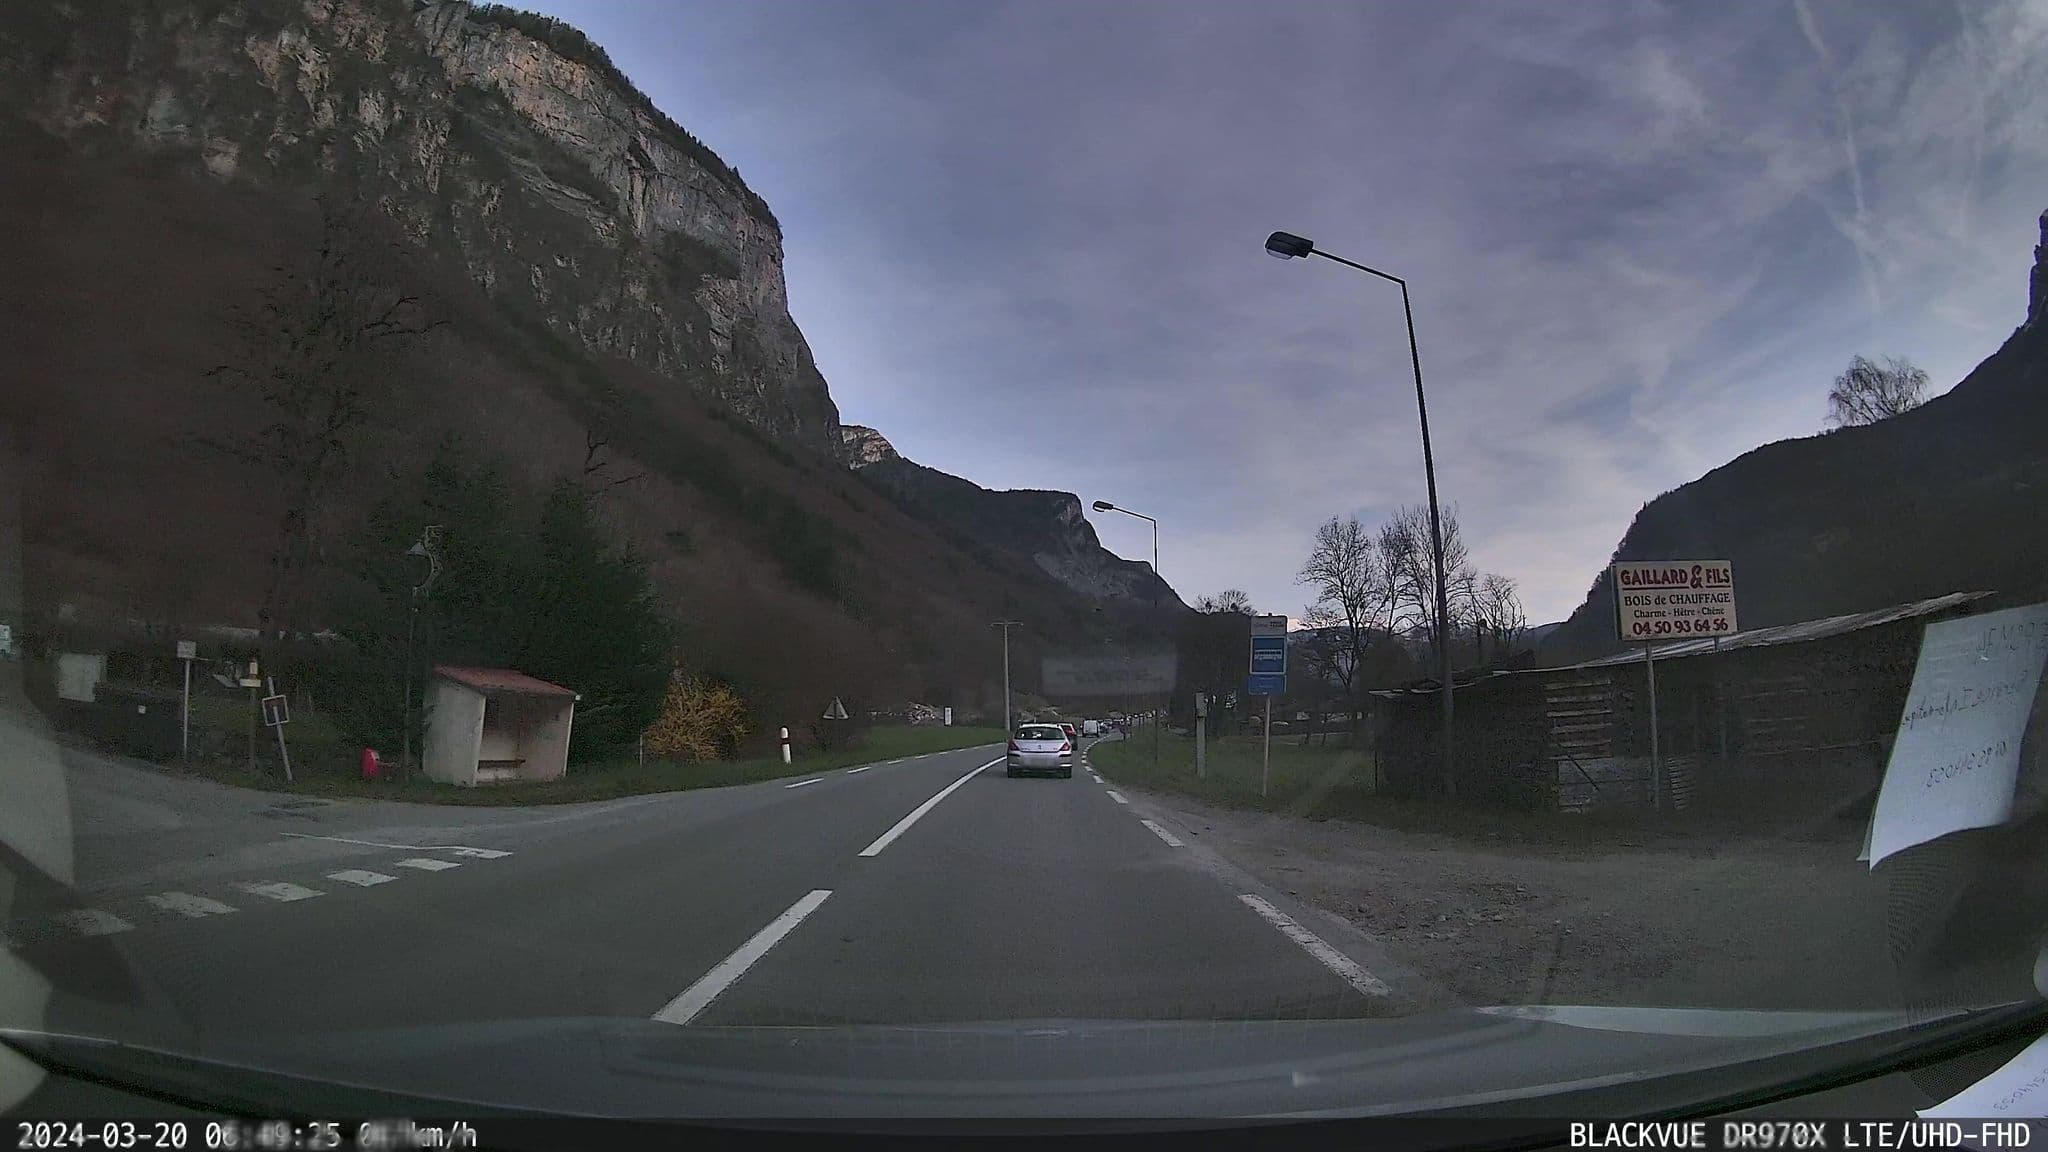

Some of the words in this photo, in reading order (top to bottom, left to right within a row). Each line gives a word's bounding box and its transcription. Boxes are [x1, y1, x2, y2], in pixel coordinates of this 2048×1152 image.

[1620, 568, 1688, 586] GAILLARD
[1690, 565, 1704, 589] &
[1705, 568, 1730, 584] FILS
[1624, 595, 1652, 606] BOIS
[1654, 595, 1667, 605] de
[1669, 593, 1731, 604] CHAUFFAGE
[1633, 609, 1667, 618] Charme
[1633, 622, 1651, 635] 04
[1654, 620, 1672, 634] 50
[1674, 620, 1692, 633] 93
[1694, 619, 1711, 632] 64
[1712, 618, 1729, 631] 56
